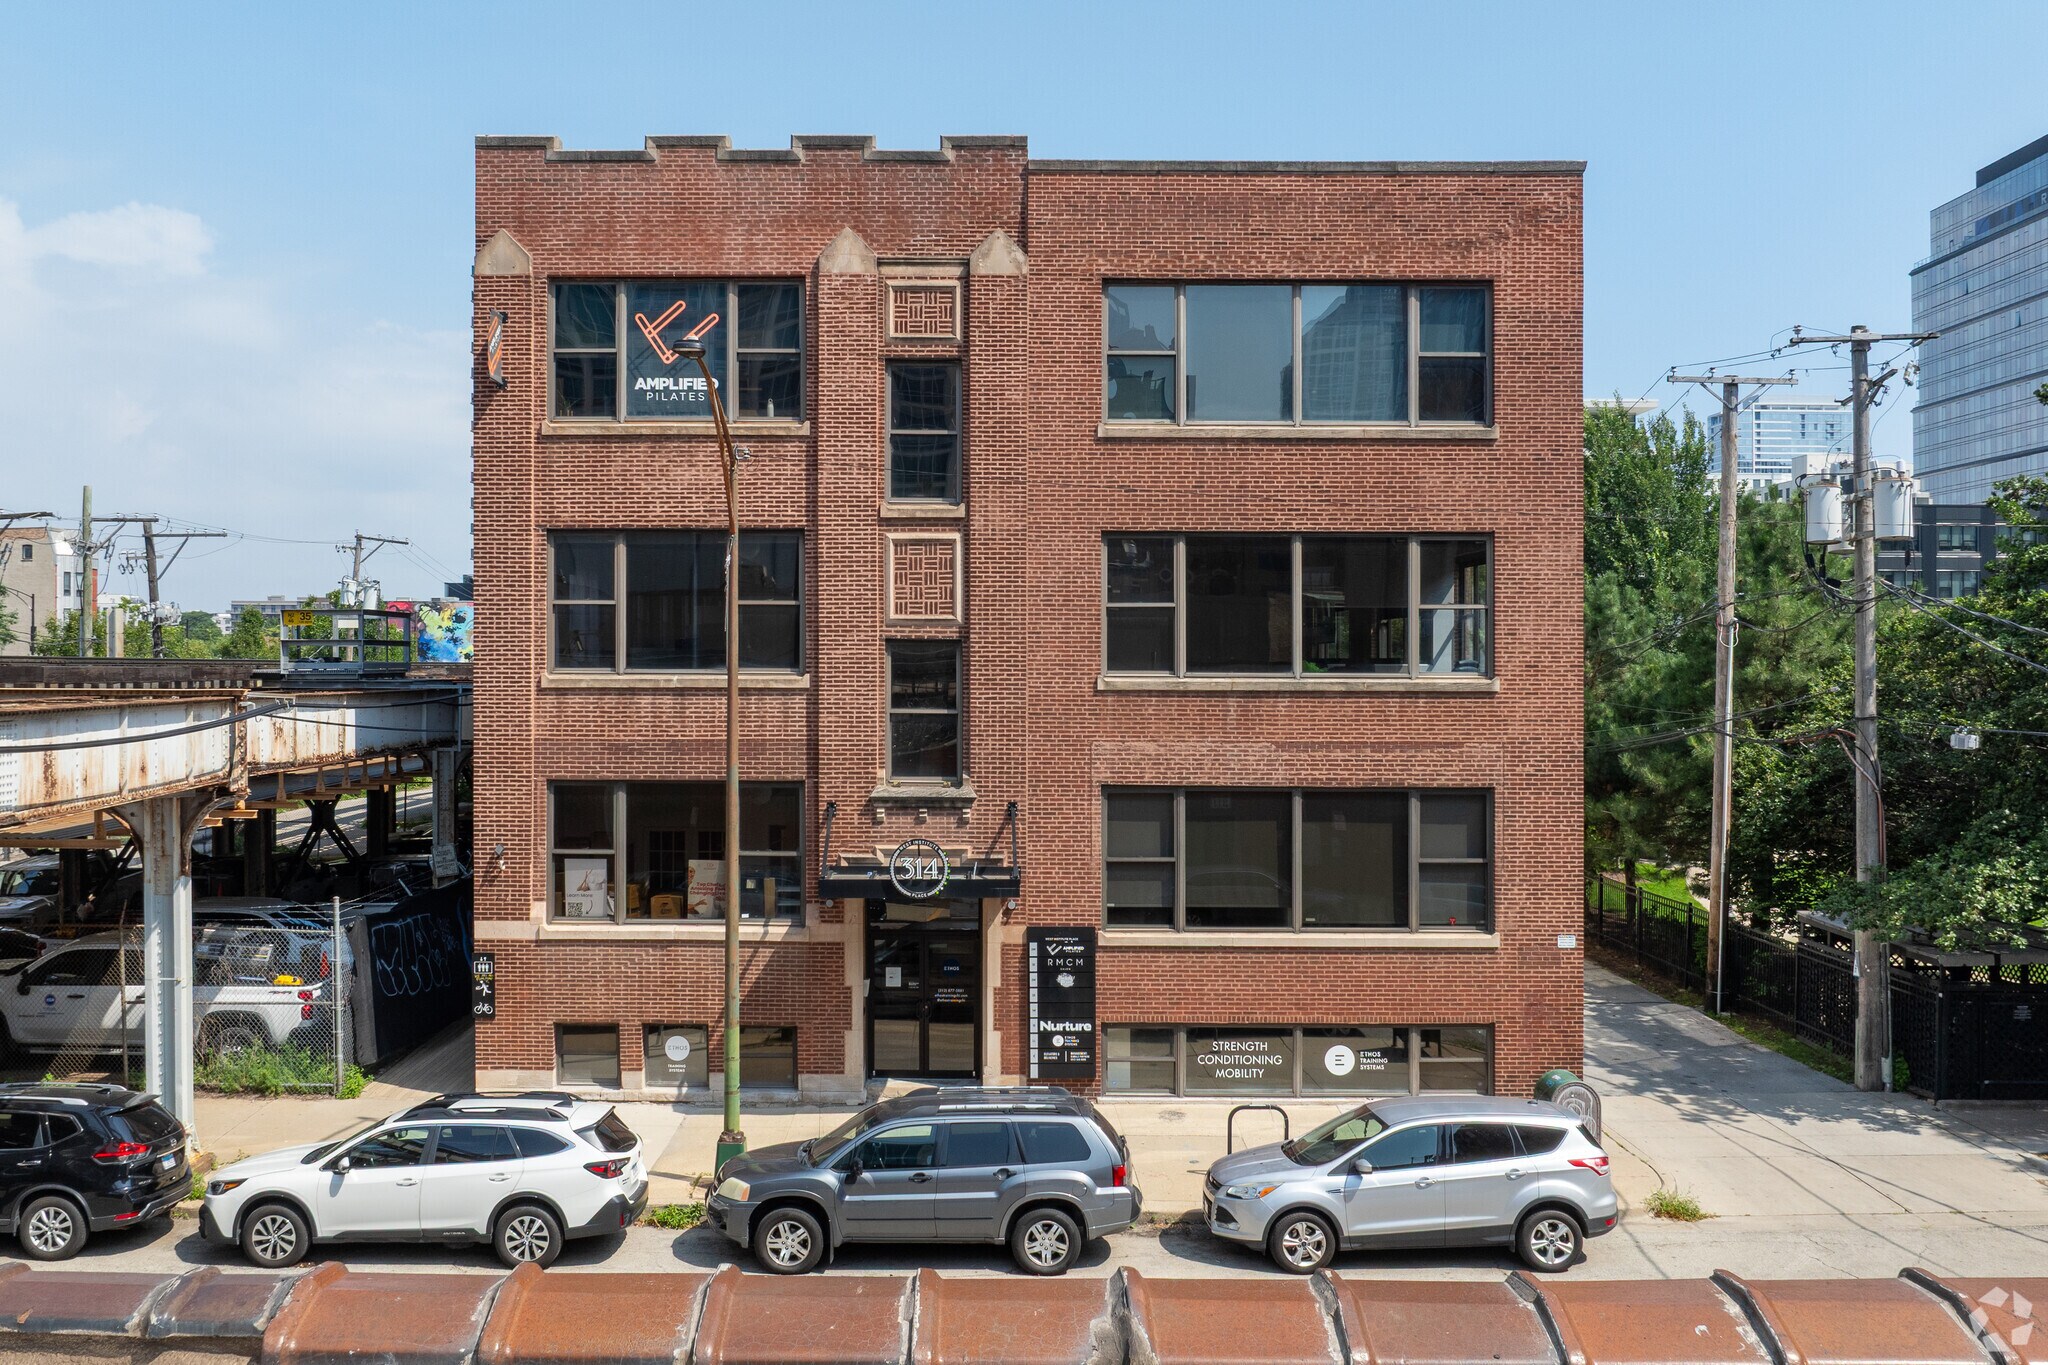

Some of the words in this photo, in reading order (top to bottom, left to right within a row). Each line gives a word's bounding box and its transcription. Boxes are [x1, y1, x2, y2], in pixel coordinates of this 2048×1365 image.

[646, 392, 705, 401] PILATES
[299, 611, 311, 620] 35
[900, 856, 938, 879] 314
[1040, 1020, 1092, 1032] Nurture
[1212, 1041, 1268, 1051] STRENGTH
[1197, 1055, 1283, 1065] CONDITIONING
[1215, 1068, 1265, 1079] MOBILITY
